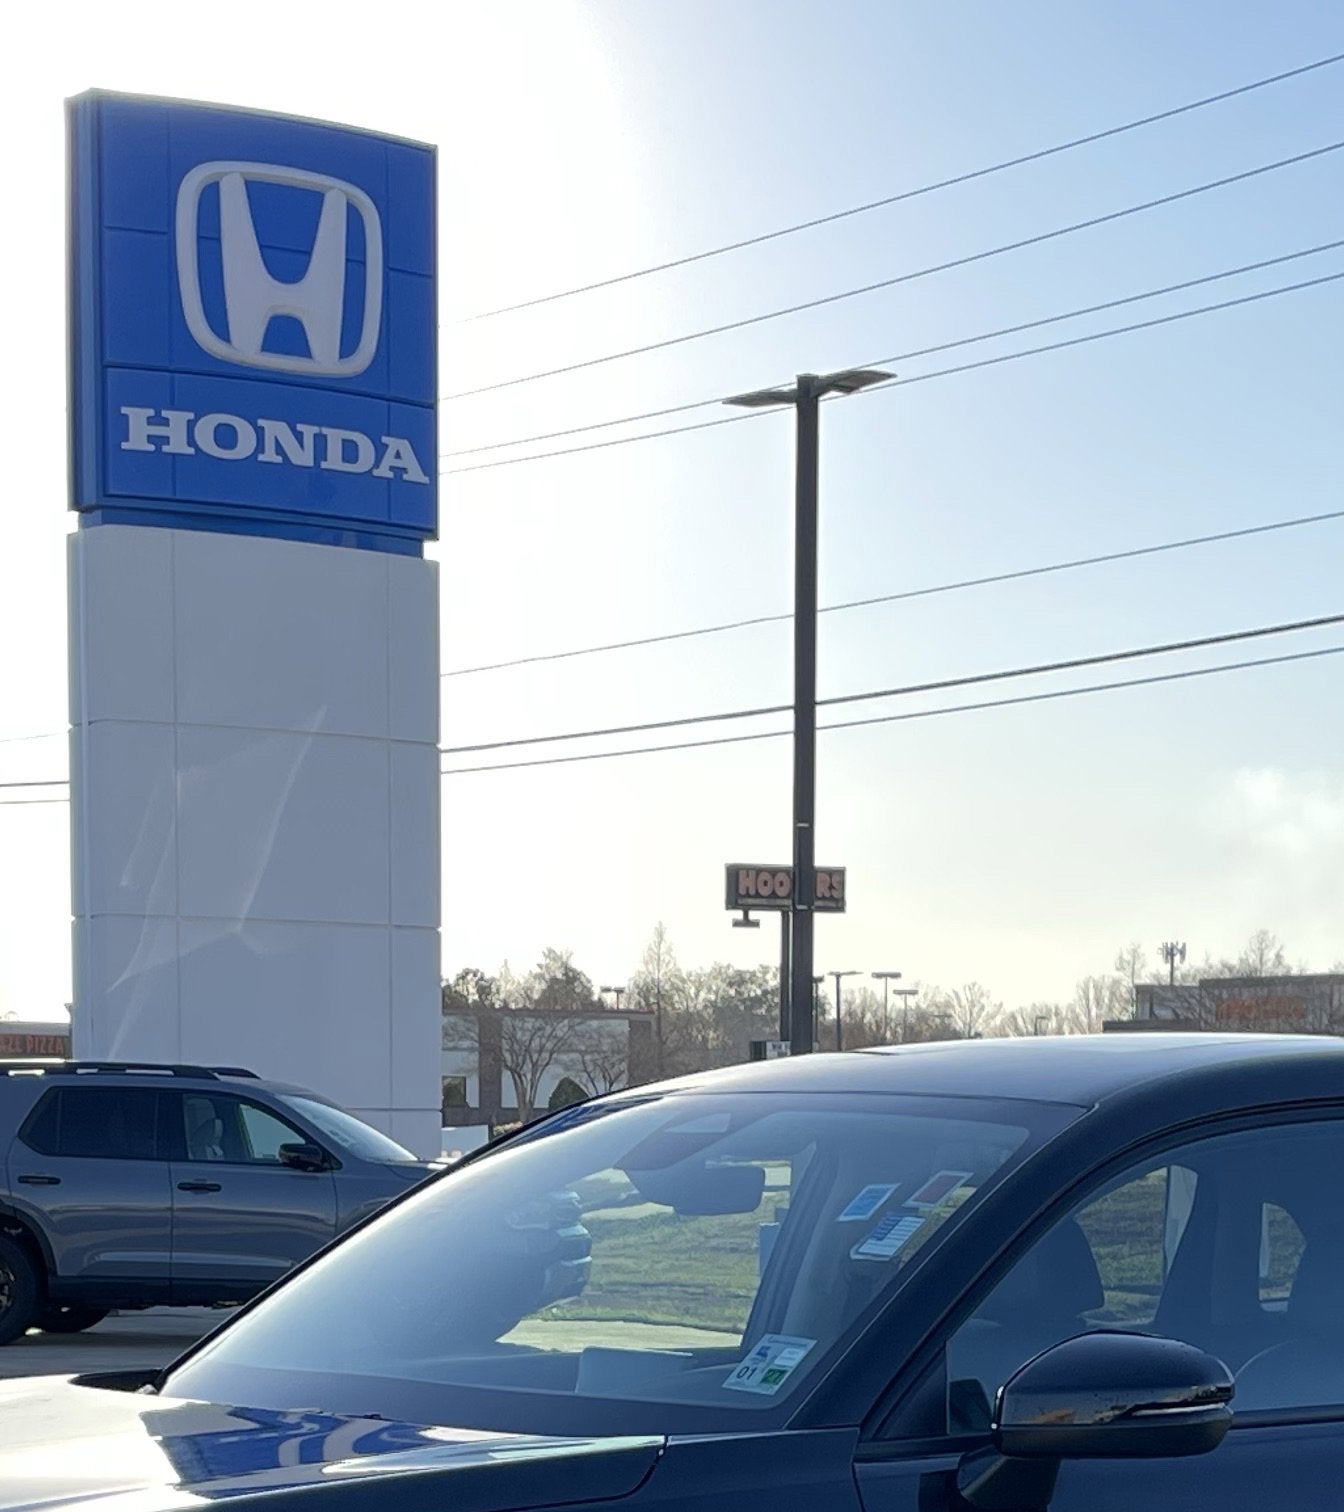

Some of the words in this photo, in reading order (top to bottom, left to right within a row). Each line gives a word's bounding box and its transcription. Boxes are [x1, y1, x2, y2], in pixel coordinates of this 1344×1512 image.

[120, 405, 430, 484] HONDA
[738, 869, 843, 899] HOORS
[25, 1036, 64, 1053] PIZZA
[736, 1366, 757, 1380] 01
